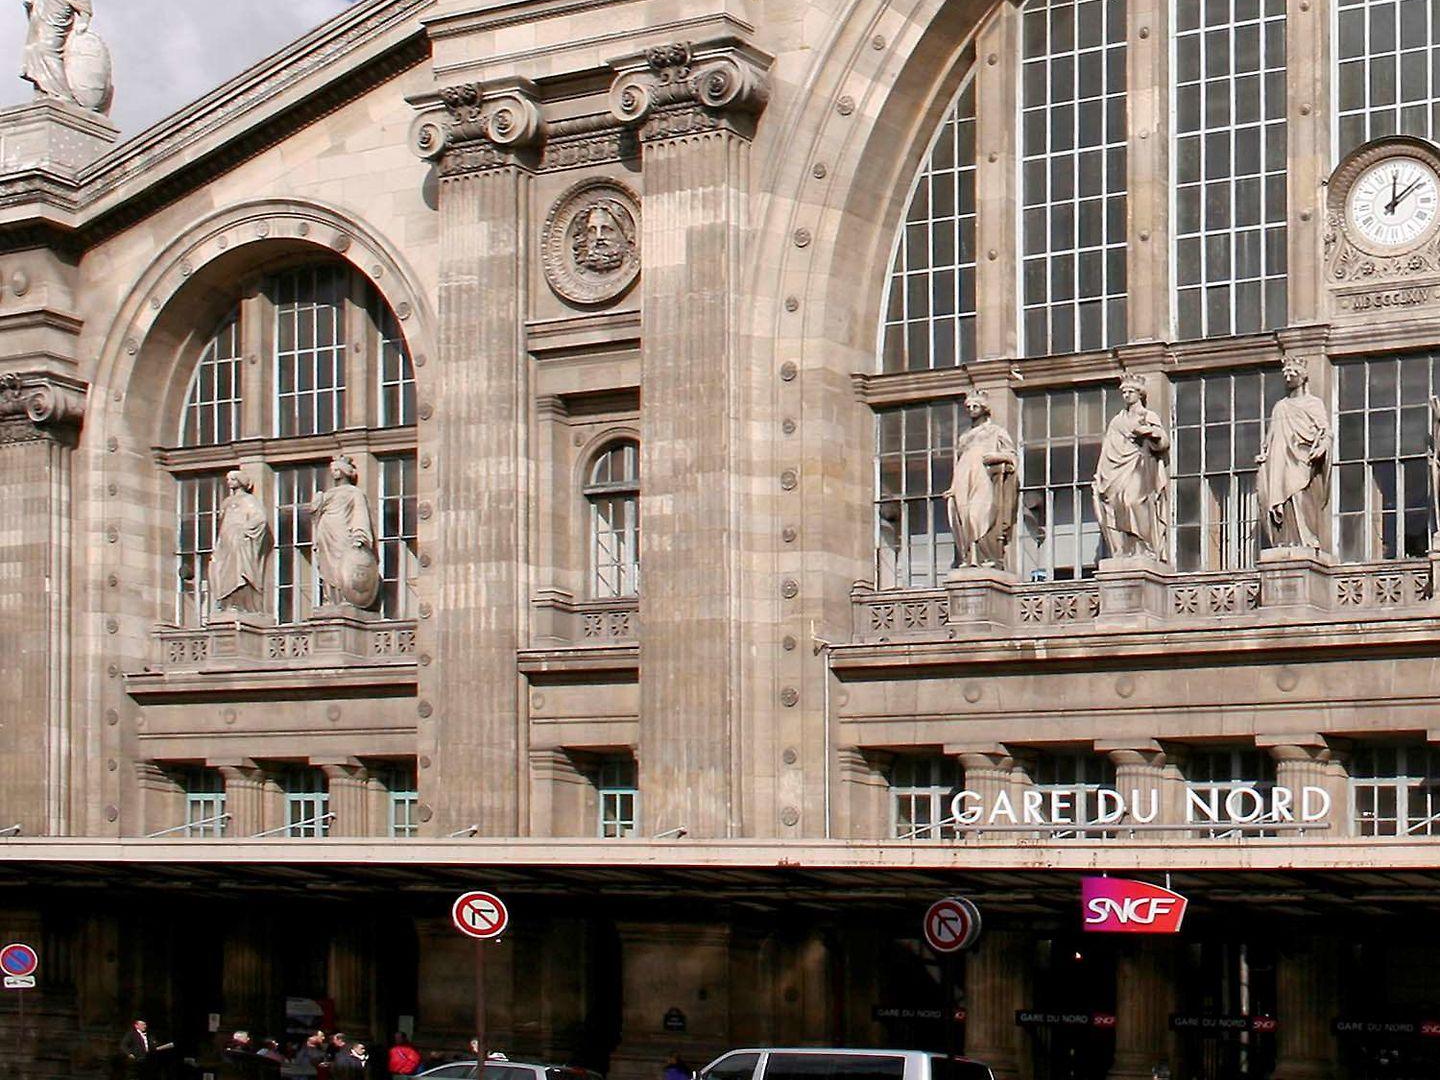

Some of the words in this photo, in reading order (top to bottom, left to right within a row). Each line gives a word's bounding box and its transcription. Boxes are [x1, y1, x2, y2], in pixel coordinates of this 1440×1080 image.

[951, 787, 1072, 824] GARE
[1097, 787, 1158, 824] DU
[1187, 786, 1331, 823] NORD
[1086, 898, 1175, 923] SNCF
